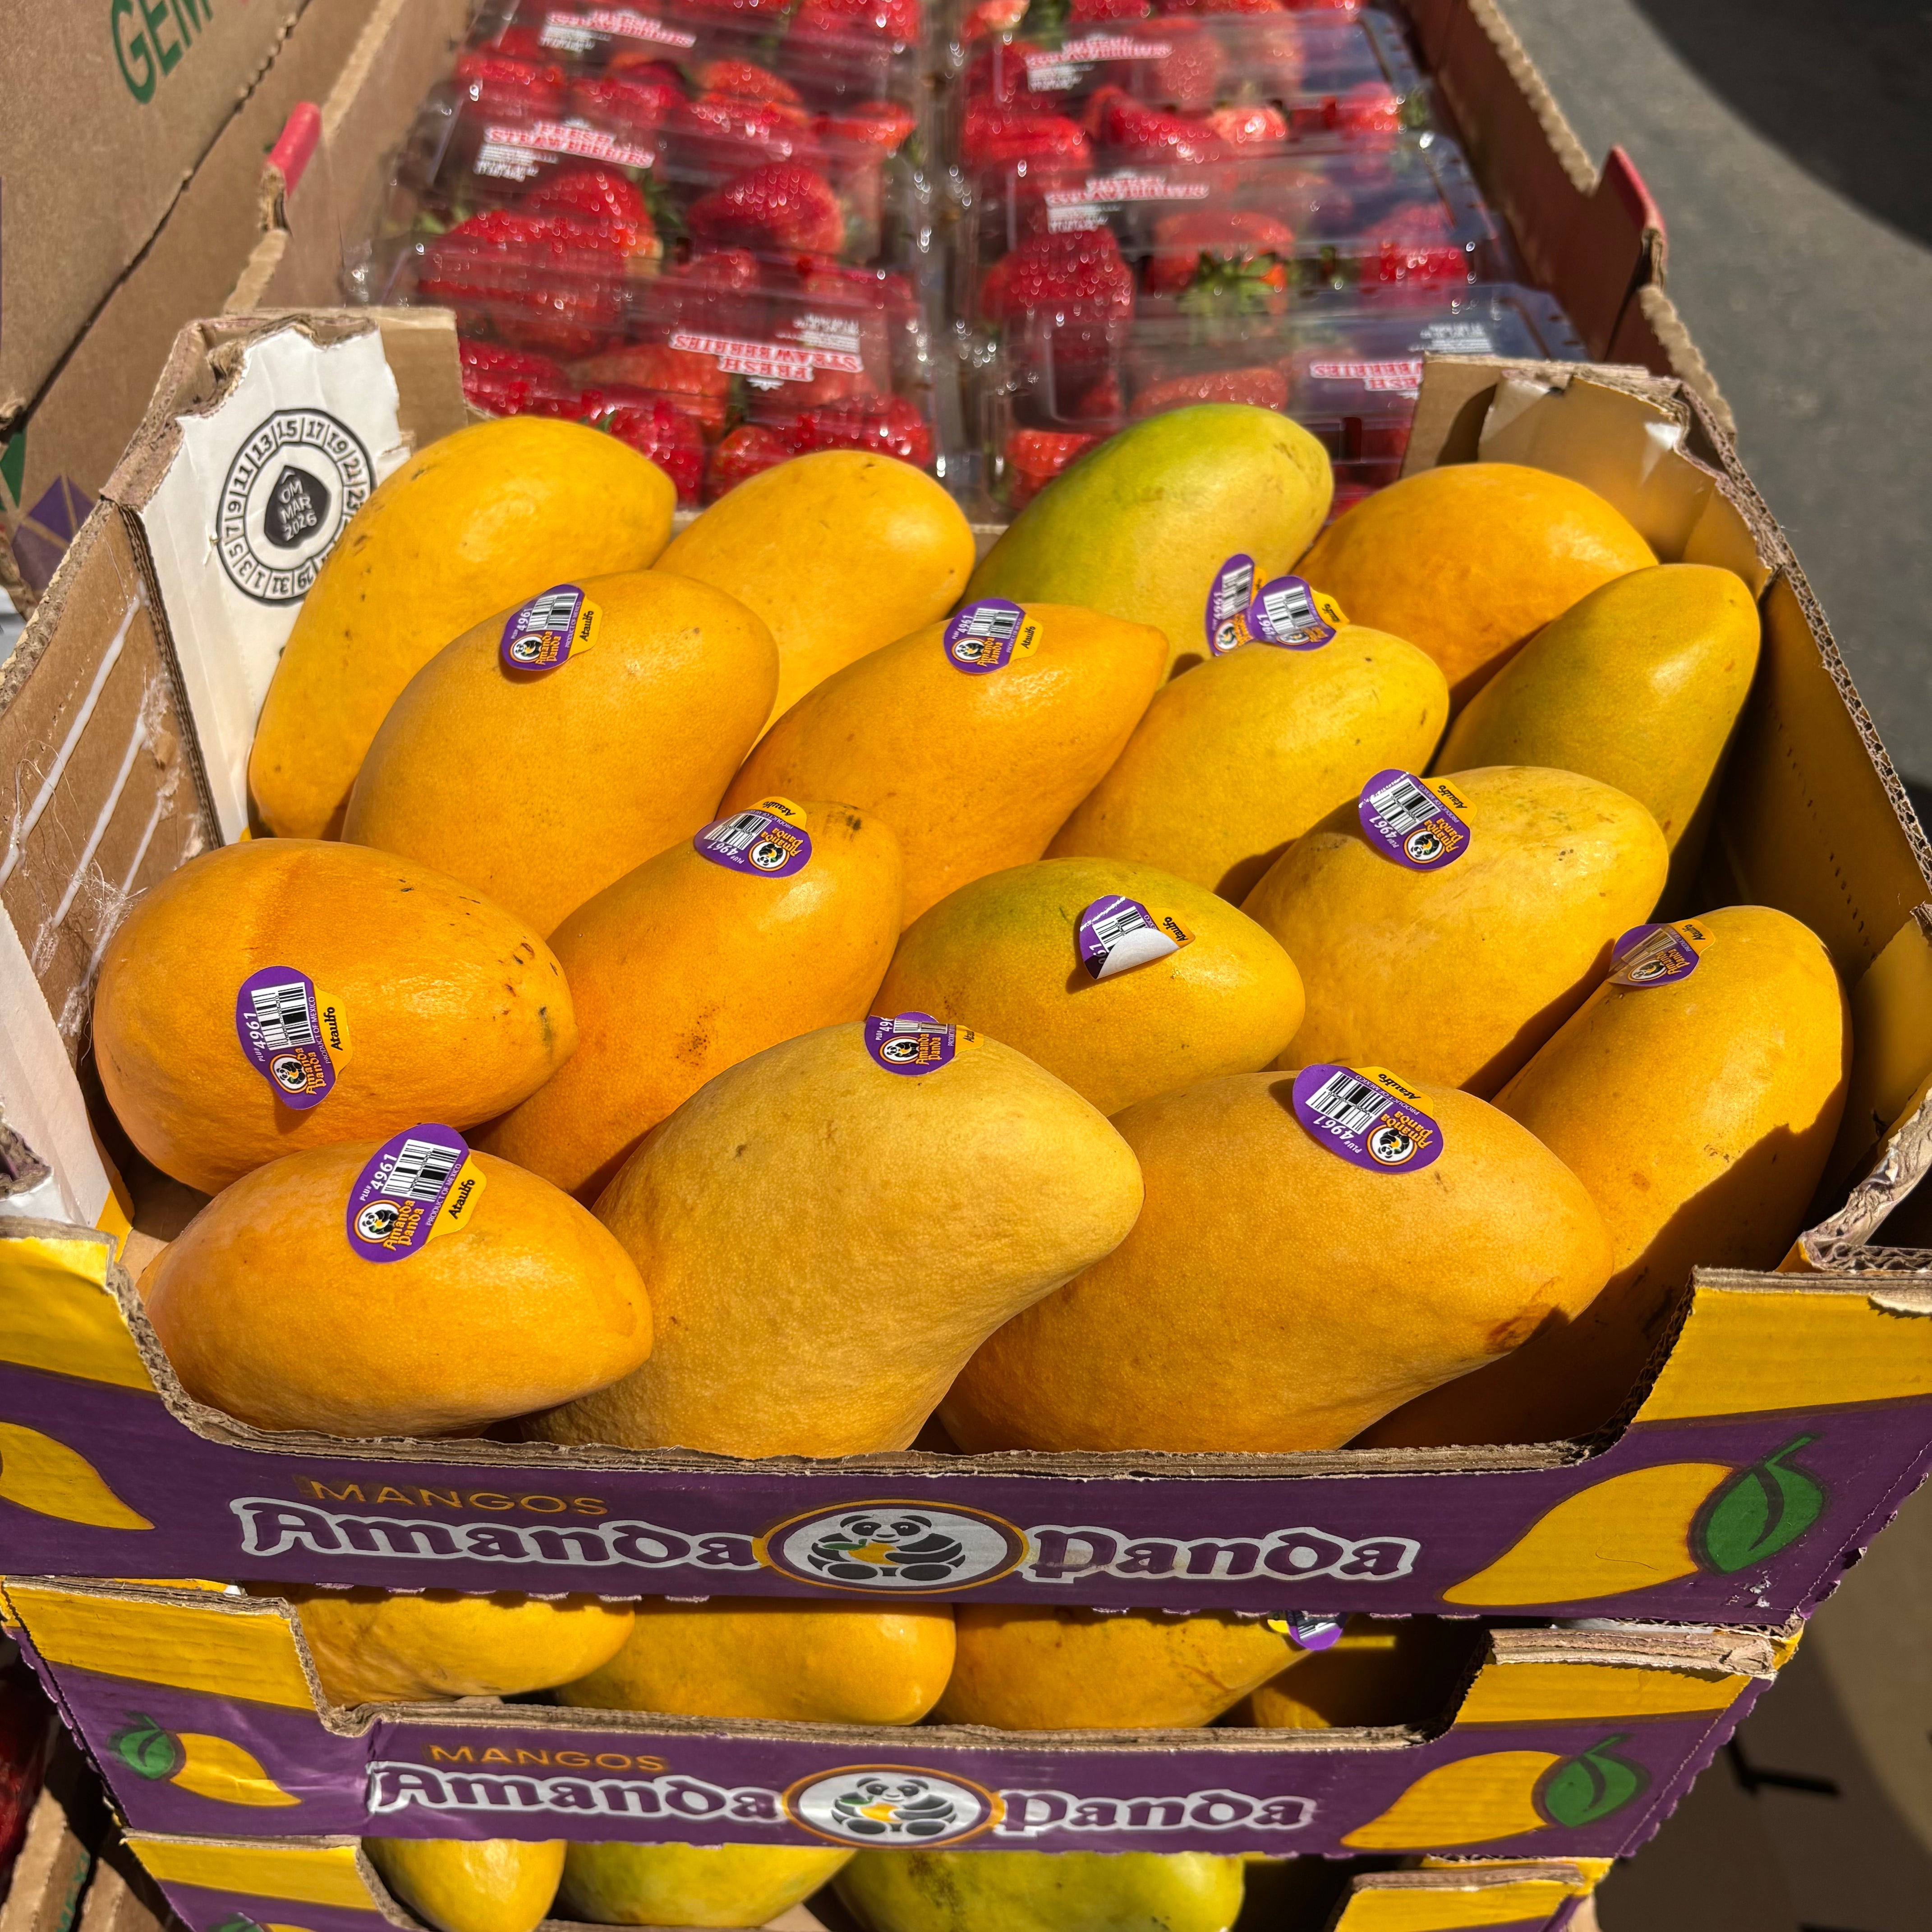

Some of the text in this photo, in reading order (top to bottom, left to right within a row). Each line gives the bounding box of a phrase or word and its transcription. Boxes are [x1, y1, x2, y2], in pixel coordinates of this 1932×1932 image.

[723, 358, 807, 380] FRESH
[1370, 378, 1417, 390] ESH
[277, 420, 298, 437] 15
[306, 421, 325, 440] 17
[253, 434, 273, 460] 13
[327, 432, 350, 453] 19
[235, 464, 254, 490] 11
[343, 457, 361, 483] 21
[228, 501, 241, 513] 9
[280, 492, 313, 524] MAR
[226, 526, 239, 538] 7
[282, 511, 317, 541] 2026
[229, 544, 244, 557] 5
[239, 561, 252, 575] 3
[272, 577, 290, 595] 31
[957, 615, 974, 634] 4961
[1437, 785, 1467, 809] Ataulfo
[1369, 816, 1397, 842] 4961
[1424, 819, 1459, 853] Amanda
[707, 841, 738, 856] 4961
[761, 831, 803, 857] Amanda
[1163, 916, 1189, 941] Ataulfo
[244, 1012, 267, 1049] 4961
[308, 997, 331, 1063] PRODUCT OF MEXICO
[323, 1007, 343, 1051] Ataulfo
[295, 1047, 317, 1095] Amanda
[1355, 1075, 1380, 1090] MEXICO
[1378, 1074, 1421, 1099] Ataulfo
[1388, 1097, 1420, 1115] PRODUCT
[1313, 1116, 1354, 1140] 4961
[1381, 1113, 1433, 1149] Amanda
[370, 1153, 398, 1191] 4961
[426, 1164, 462, 1226] PRODUCT OF MEXICO
[448, 1179, 476, 1219] Ataulfo
[383, 1200, 415, 1251] Amanda
[310, 1479, 609, 1516] MANGOS
[229, 1497, 763, 1571] Amanda
[428, 1744, 667, 1773] MANGOS
[367, 1761, 784, 1825] Amanda
